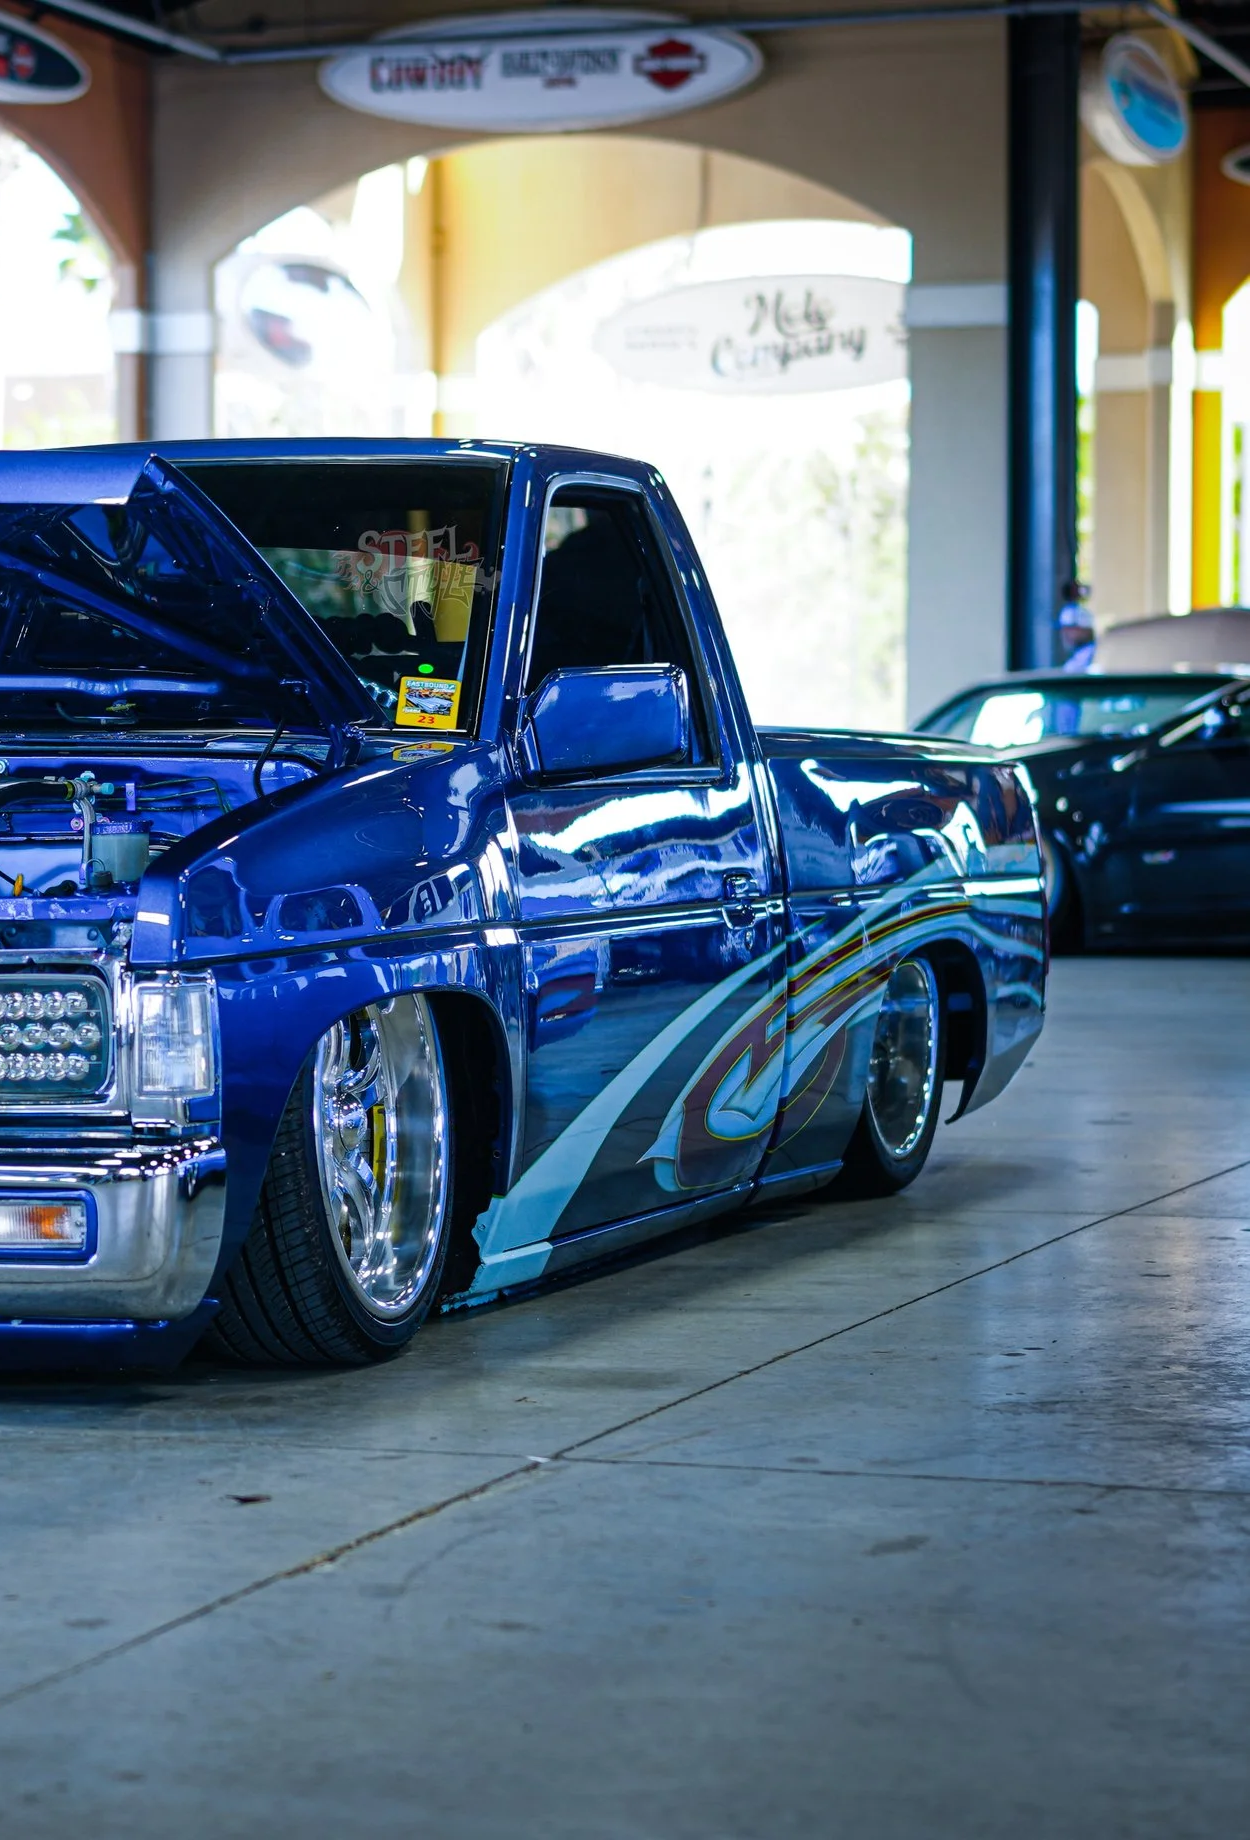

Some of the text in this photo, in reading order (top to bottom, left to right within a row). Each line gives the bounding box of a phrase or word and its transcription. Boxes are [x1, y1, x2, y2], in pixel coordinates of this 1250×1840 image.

[357, 525, 473, 575] STEEL
[362, 570, 379, 593] &
[417, 715, 435, 725] 23
